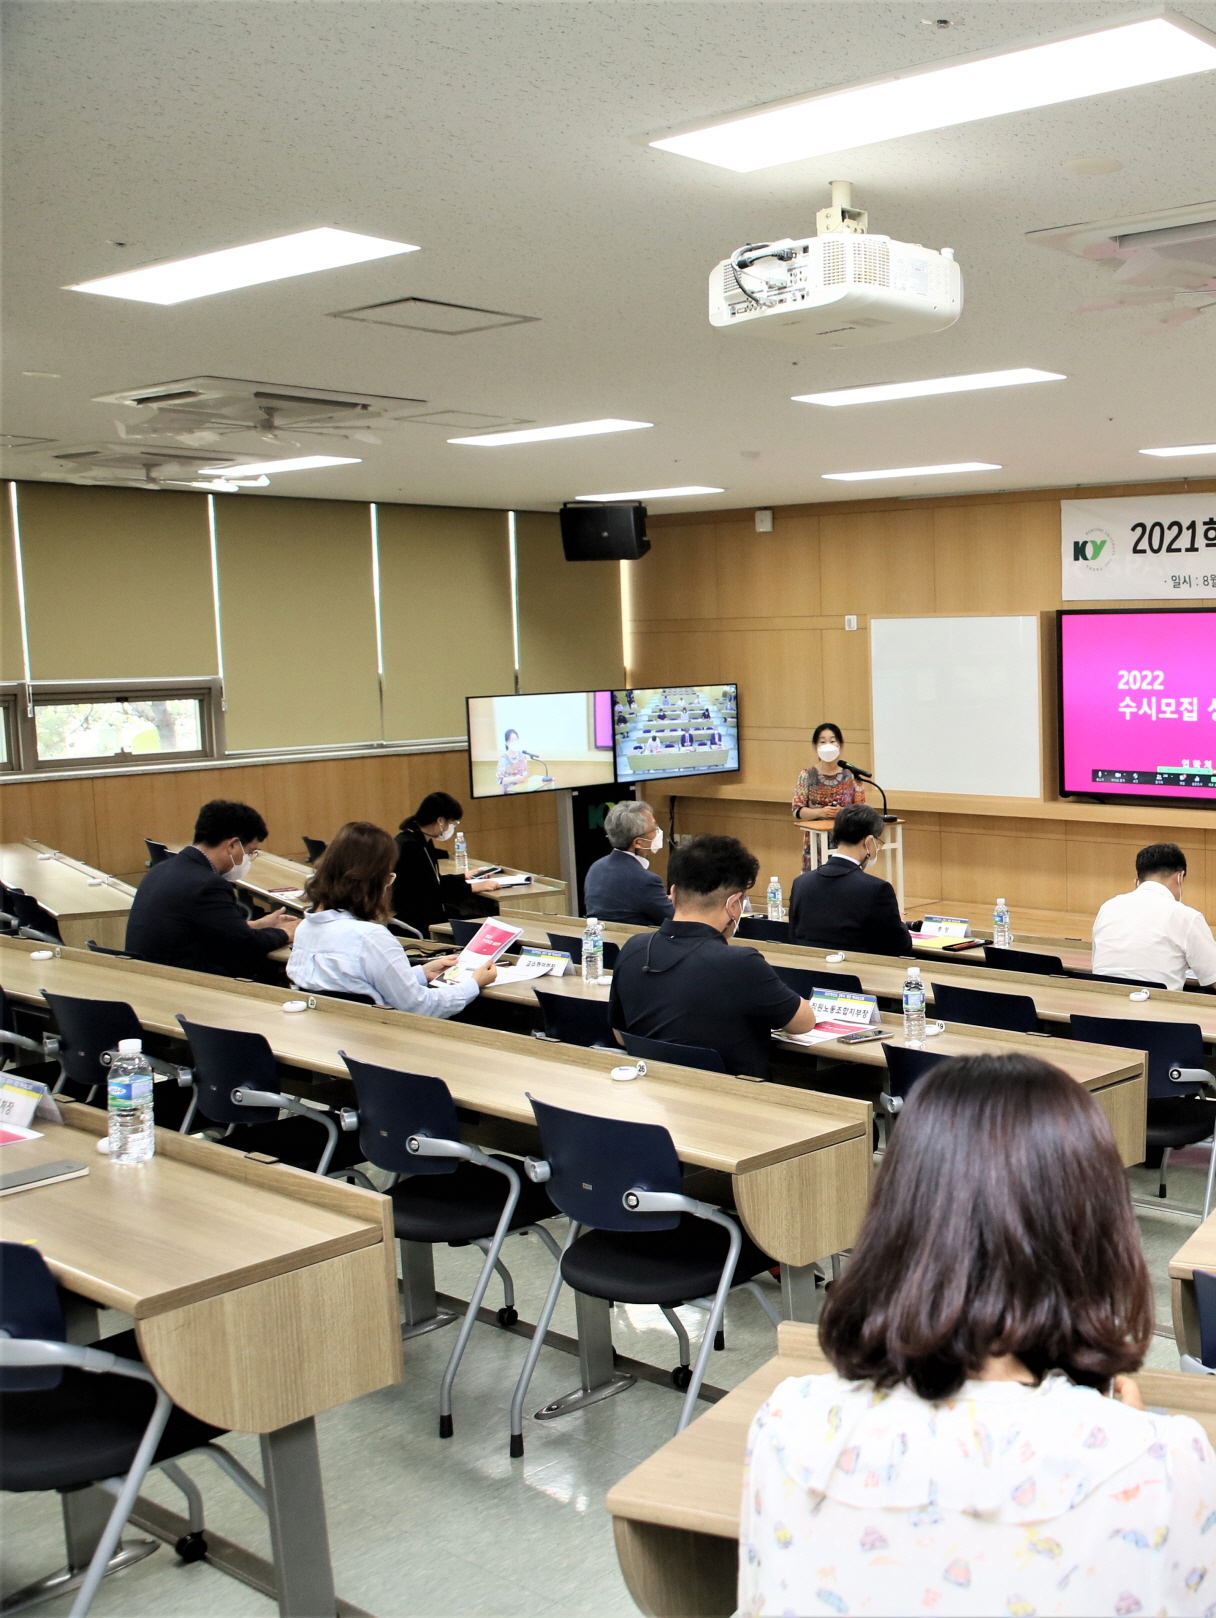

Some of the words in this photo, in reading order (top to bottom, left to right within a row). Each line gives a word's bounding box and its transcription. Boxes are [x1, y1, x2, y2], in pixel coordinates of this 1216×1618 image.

[1073, 539, 1107, 562] KY
[1170, 574, 1192, 588] 일시
[1117, 670, 1165, 690] 2022
[1117, 696, 1199, 721] 수시모집
